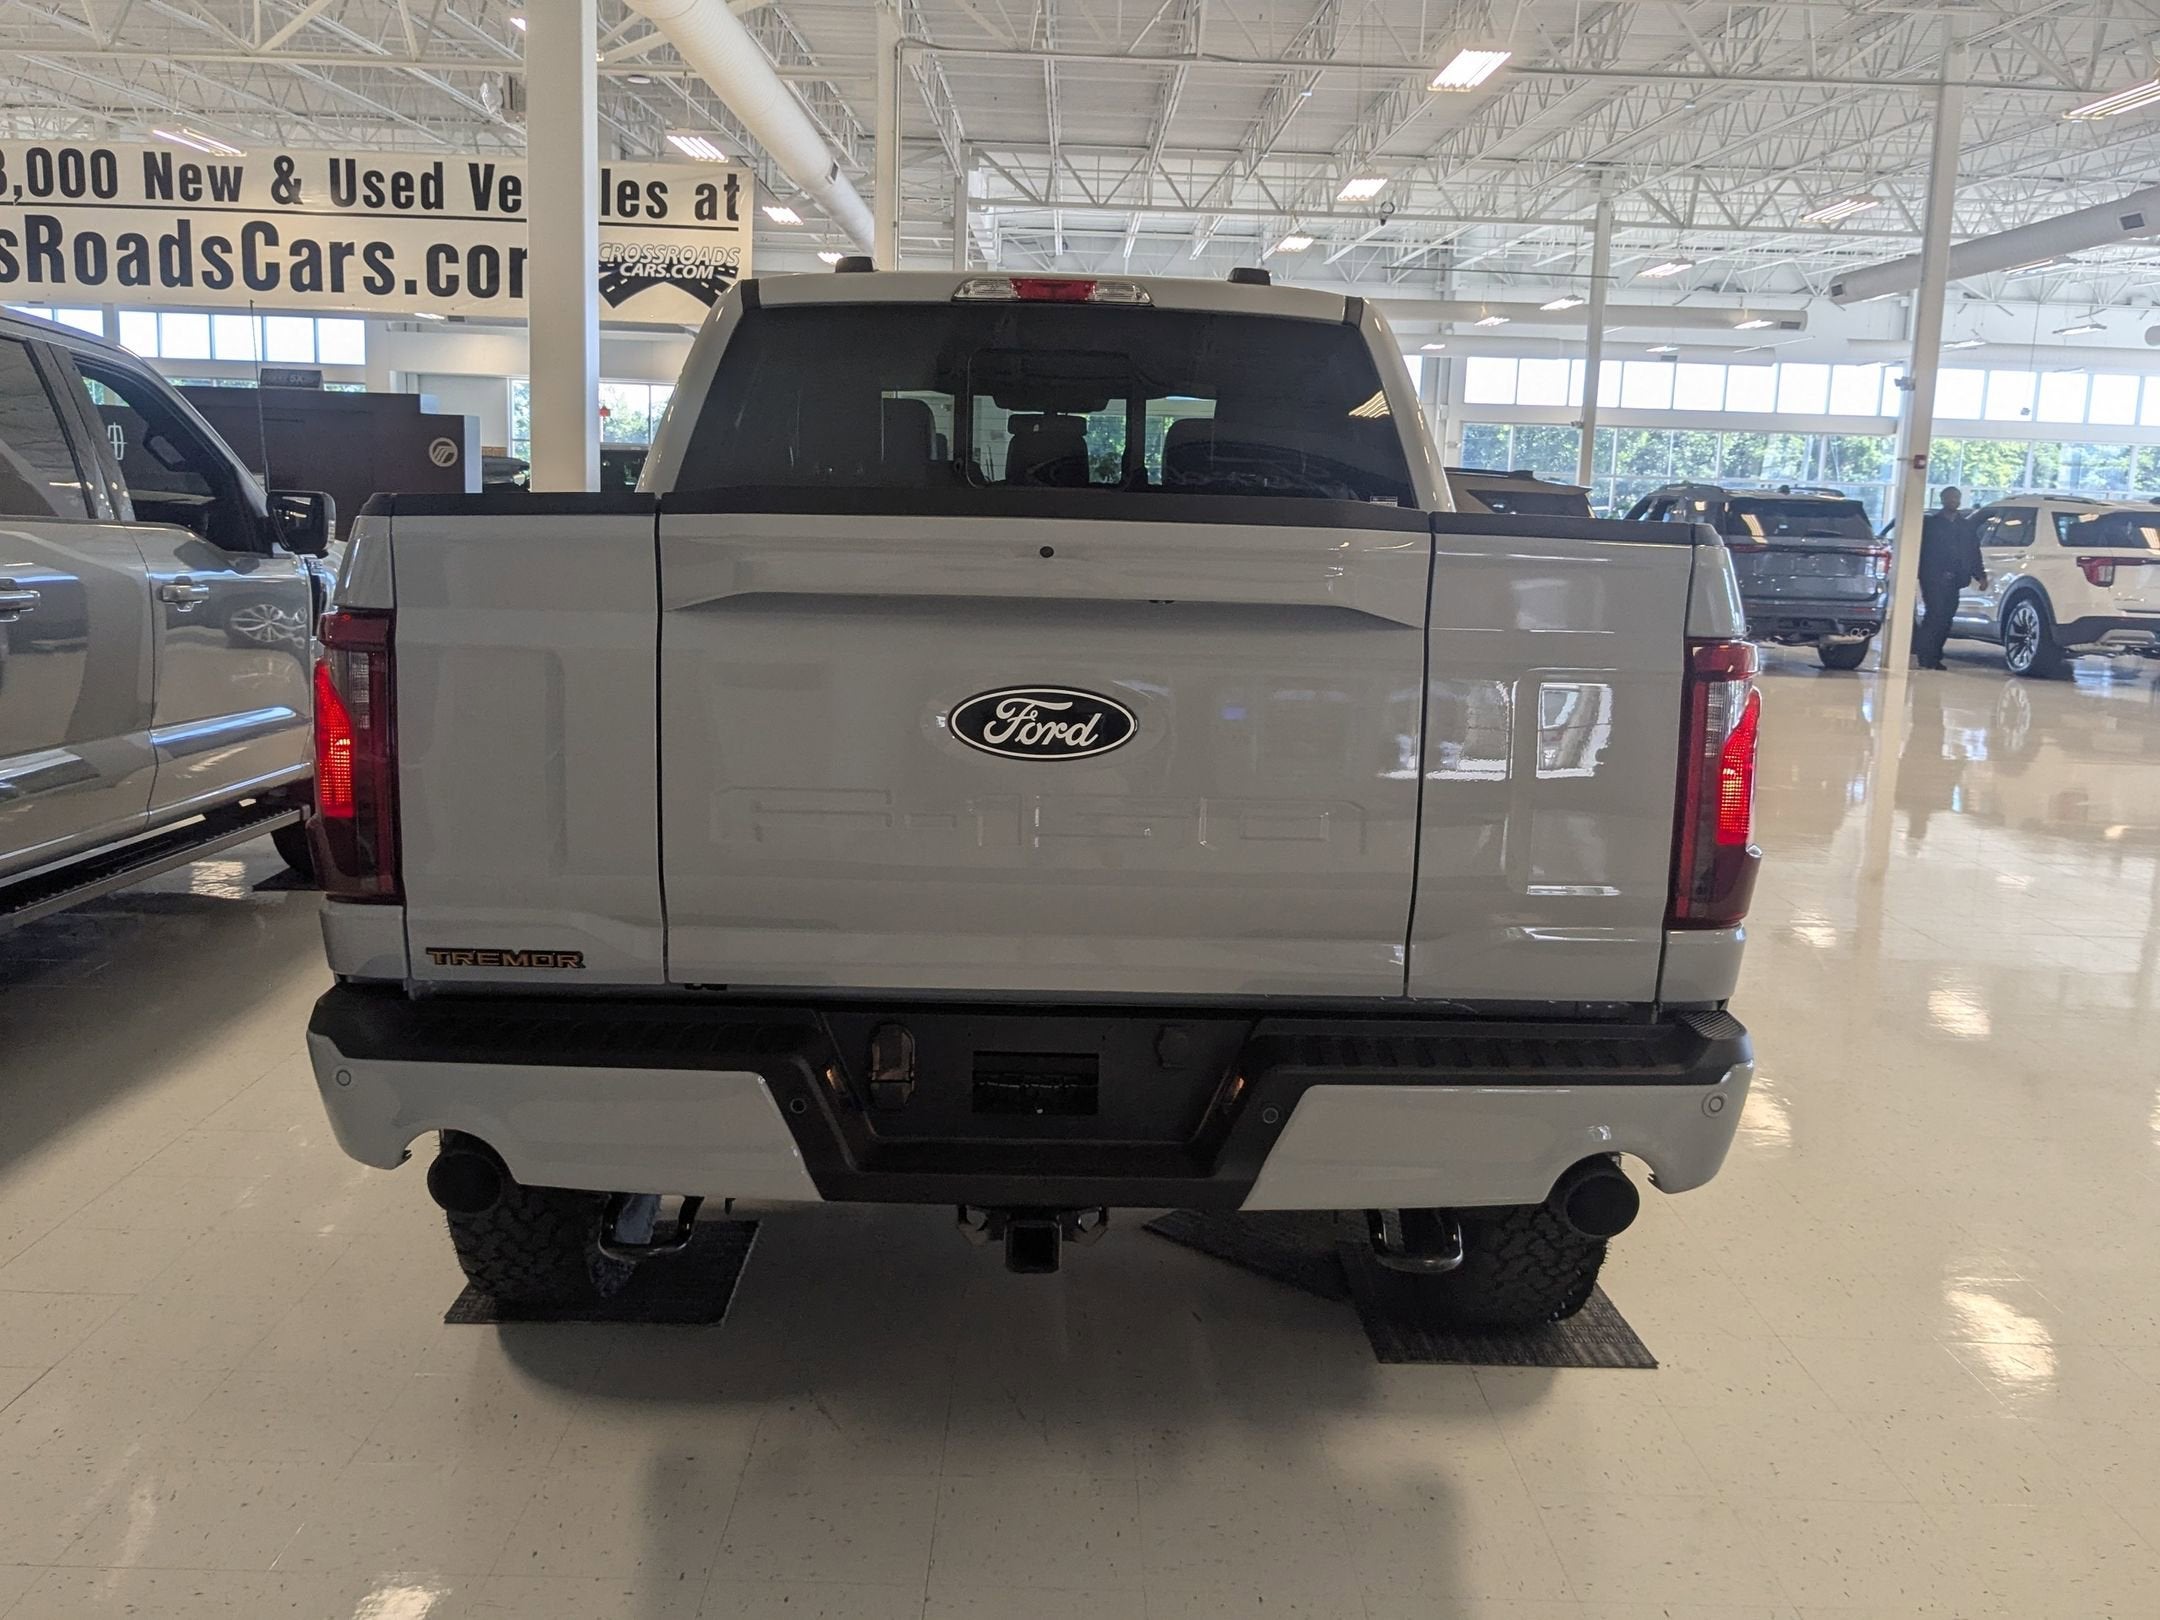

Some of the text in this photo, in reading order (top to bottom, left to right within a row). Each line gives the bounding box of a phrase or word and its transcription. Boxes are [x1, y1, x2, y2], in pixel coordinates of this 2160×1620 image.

[0, 147, 740, 221] ,000 New & Used Veles at
[598, 243, 741, 266] CROSSROADS
[619, 262, 714, 280] CARS.COM
[983, 698, 1102, 746] Ford
[426, 947, 586, 969] TREMOR
